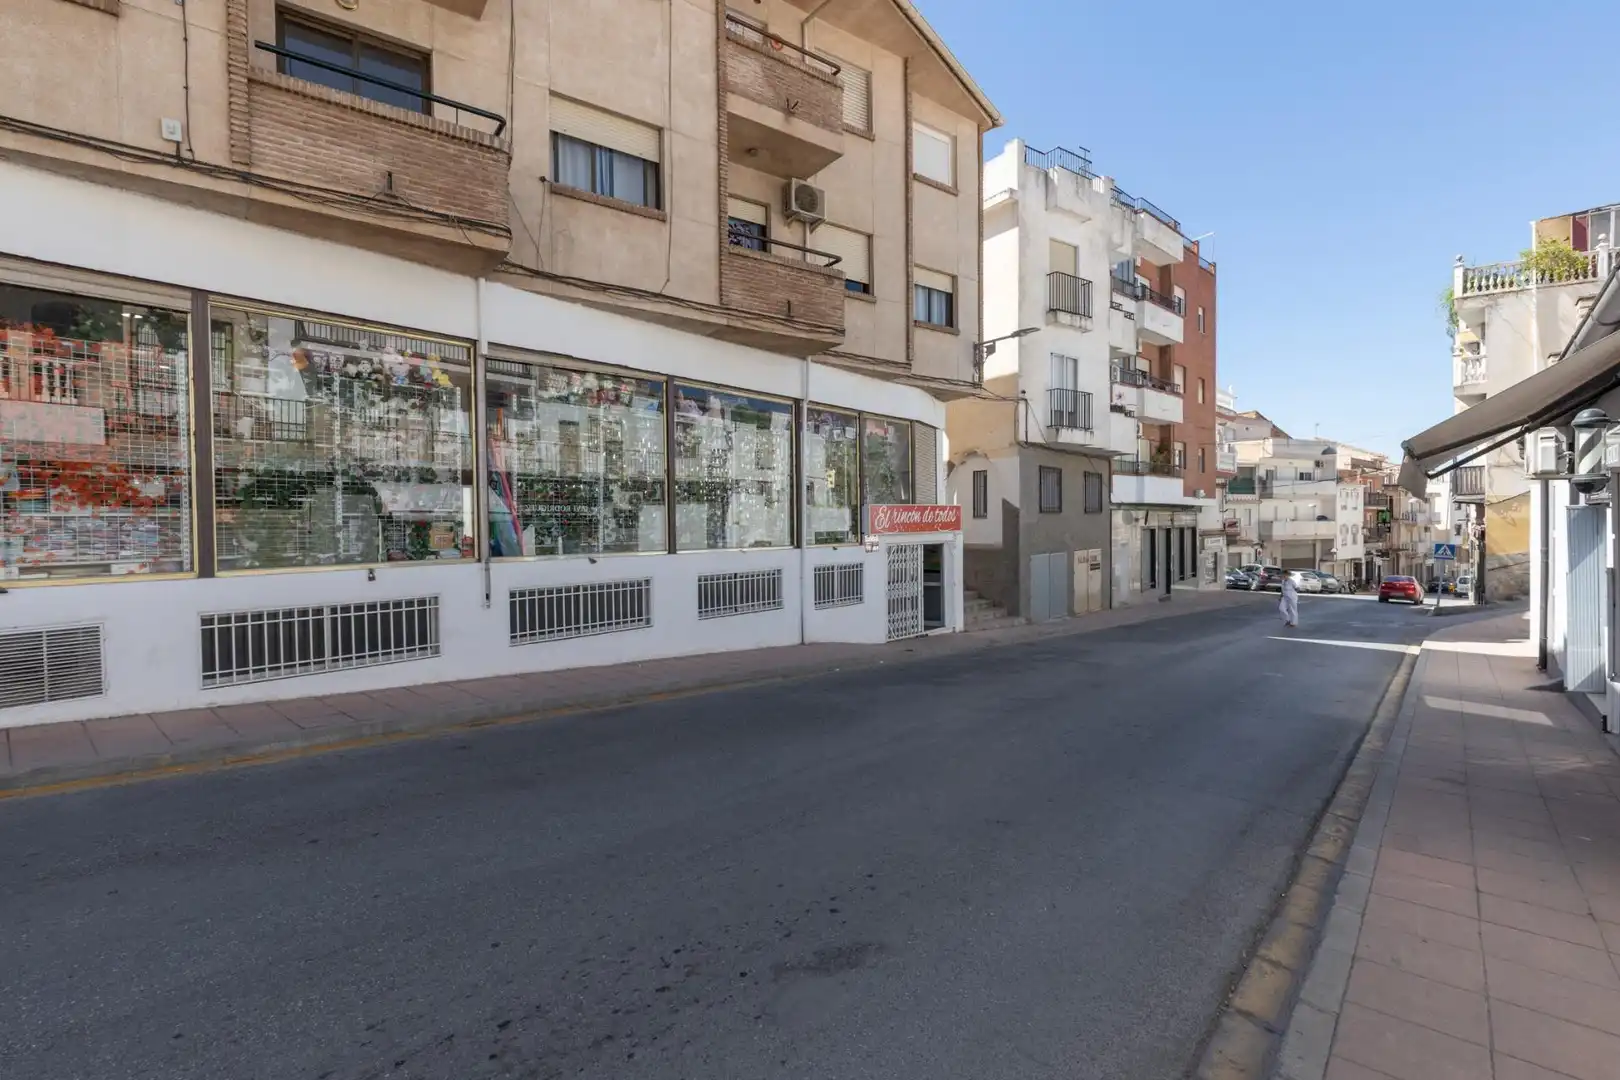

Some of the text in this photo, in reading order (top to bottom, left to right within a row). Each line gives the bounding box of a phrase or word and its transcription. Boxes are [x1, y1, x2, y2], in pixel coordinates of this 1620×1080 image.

[875, 506, 890, 529] El
[892, 506, 921, 523] rincón
[935, 506, 957, 522] todos
